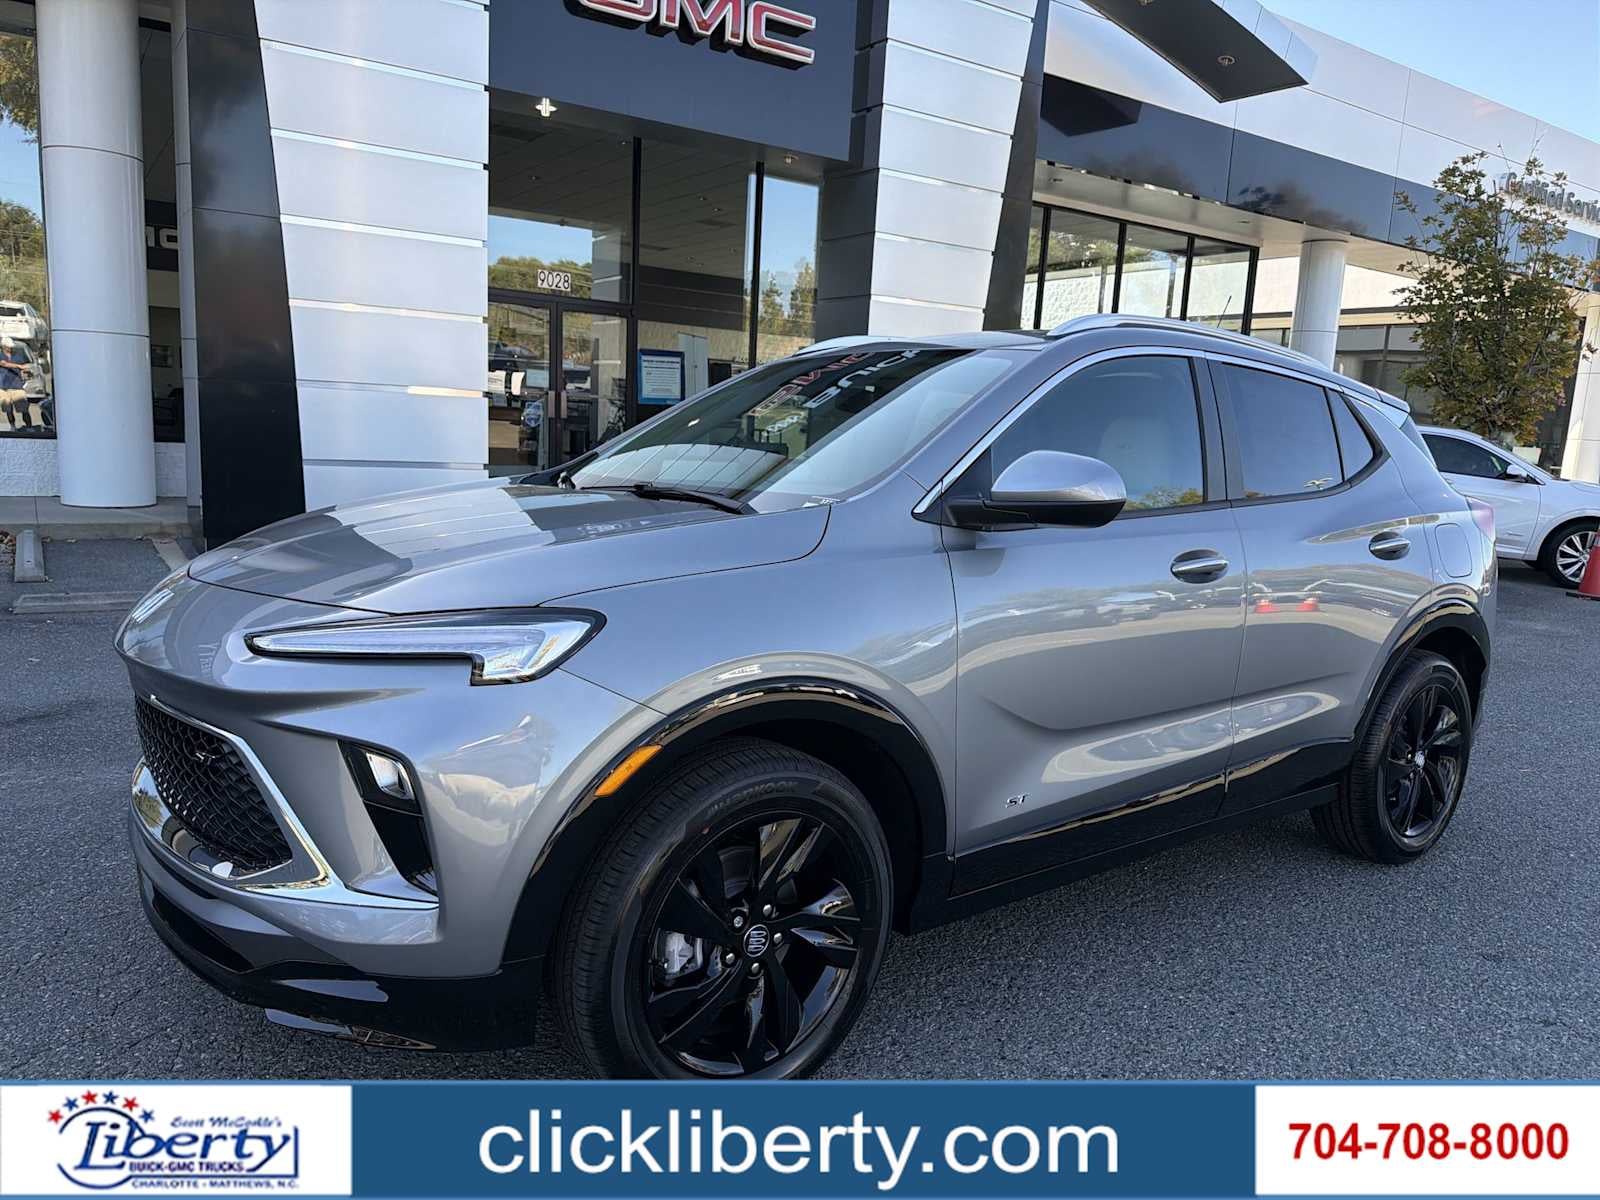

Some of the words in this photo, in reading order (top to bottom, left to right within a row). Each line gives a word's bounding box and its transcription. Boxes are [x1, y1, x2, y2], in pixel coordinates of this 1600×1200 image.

[1506, 171, 1565, 211] Crtified
[1565, 191, 1600, 223] Servi
[538, 271, 571, 290] 9028
